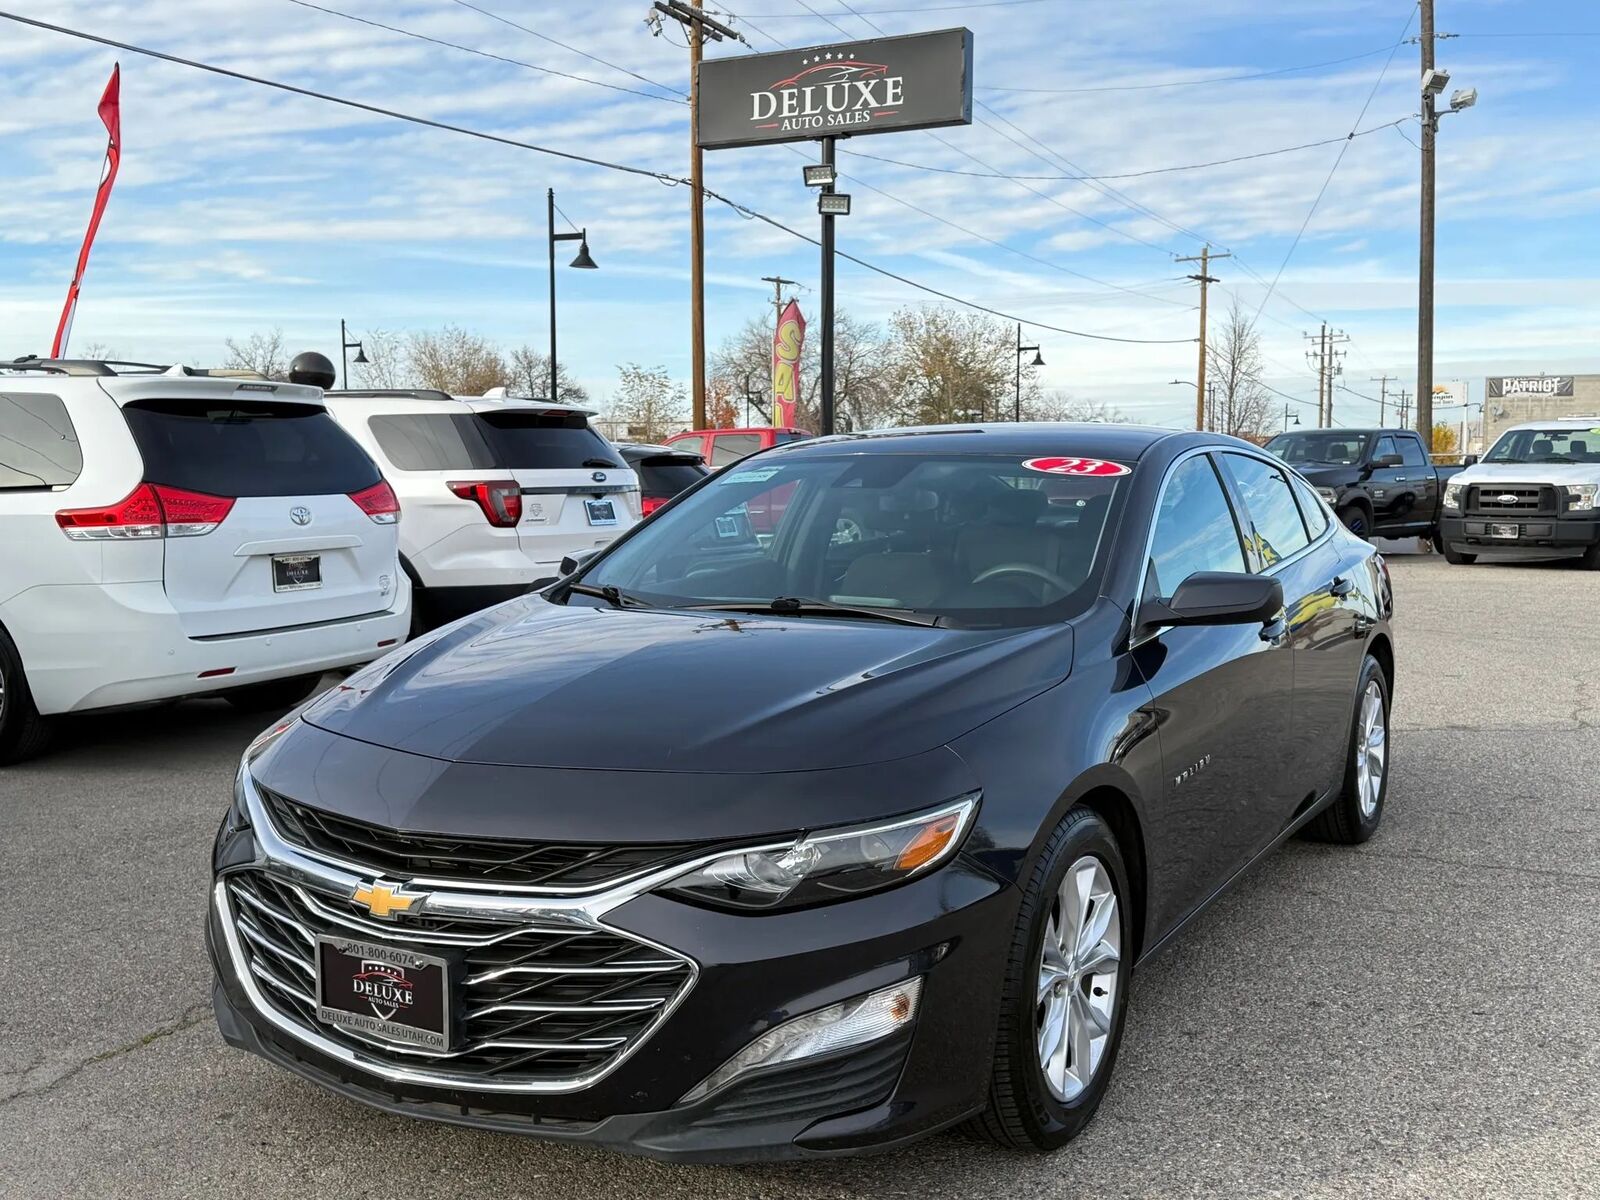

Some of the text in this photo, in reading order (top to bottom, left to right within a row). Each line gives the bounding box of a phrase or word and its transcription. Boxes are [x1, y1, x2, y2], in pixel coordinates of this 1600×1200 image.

[750, 77, 904, 121] DELUXE
[781, 110, 870, 131] AUTO SALES
[1502, 377, 1560, 395] PATRIOT
[1046, 459, 1103, 474] 23
[346, 943, 415, 966] 801-800-6074
[352, 979, 414, 1005] DELUXE
[368, 996, 399, 1009] AUTO SALES
[321, 1010, 353, 1026] DELUXE
[354, 1017, 375, 1031] AUTO
[377, 1022, 401, 1037] SALES
